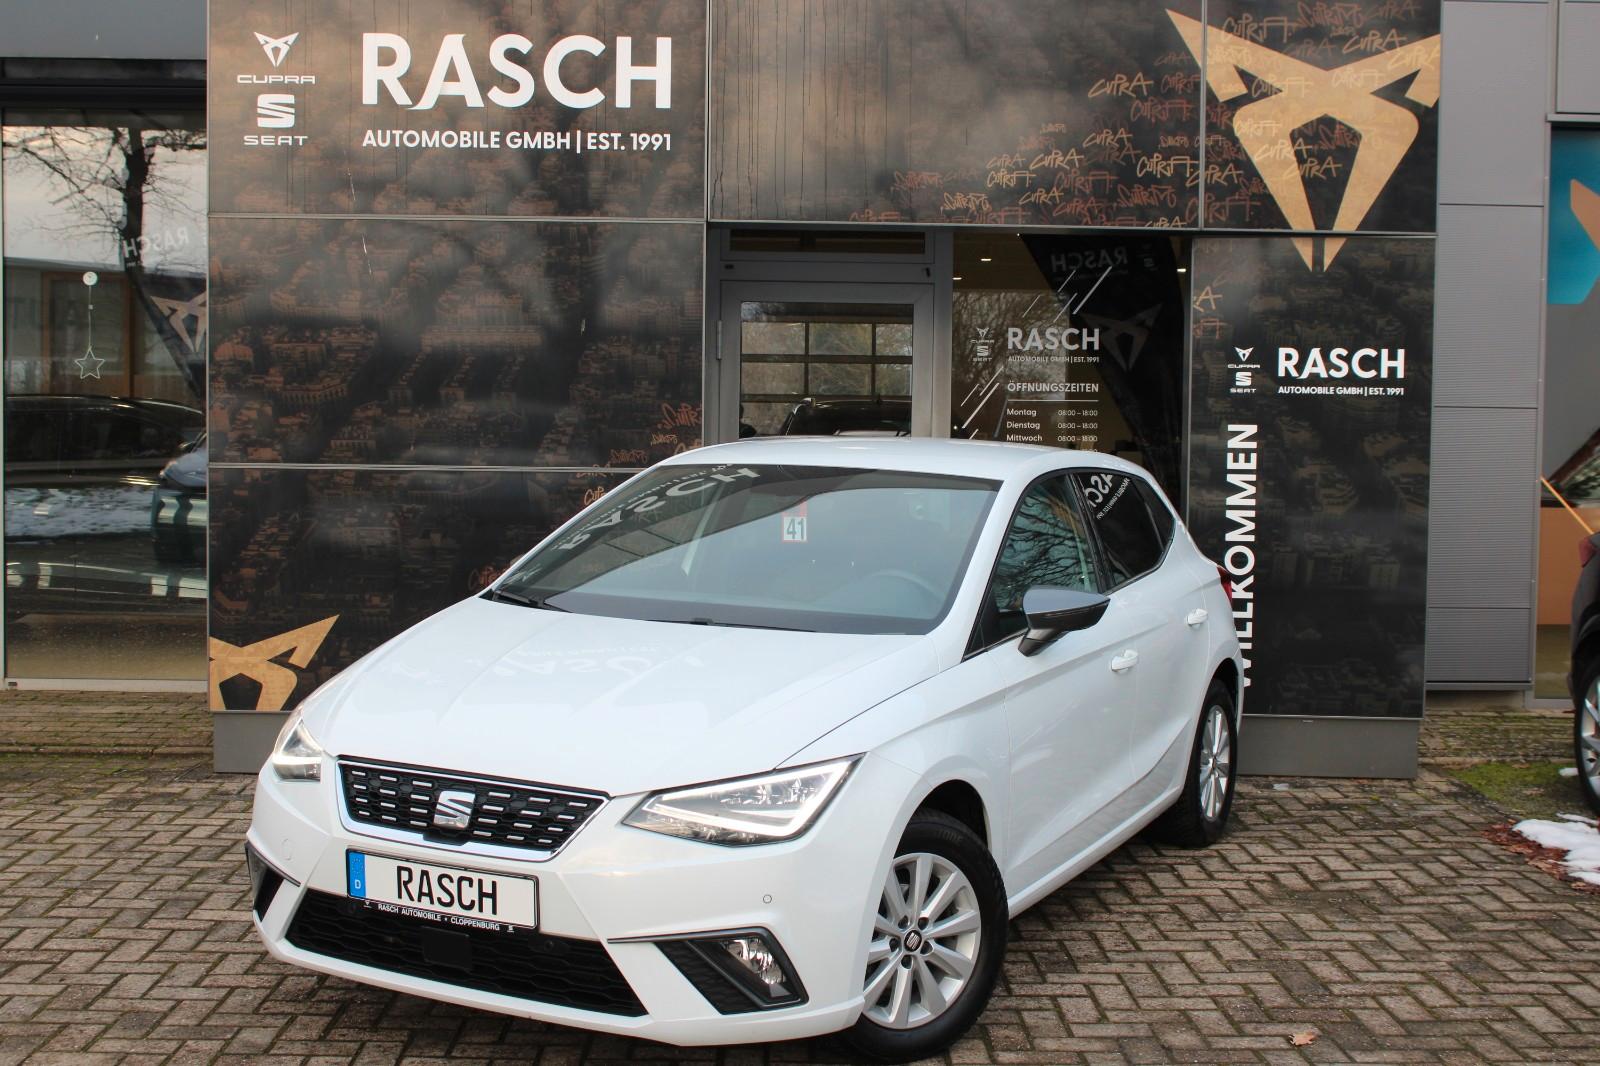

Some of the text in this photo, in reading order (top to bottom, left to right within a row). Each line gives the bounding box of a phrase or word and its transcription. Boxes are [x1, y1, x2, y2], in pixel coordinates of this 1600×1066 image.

[237, 75, 316, 84] CUPRA
[362, 32, 672, 110] RASCH
[243, 135, 309, 146] SEAT
[362, 130, 500, 148] AUTOMOBILE
[505, 131, 571, 149] GMBH
[586, 132, 625, 150] EST.
[630, 133, 671, 151] 1991
[1007, 327, 1100, 351] RASCH
[1277, 347, 1405, 379] RASCH
[1007, 380, 1099, 392] ÖFFNUNGSZEITEN
[1278, 386, 1335, 395] AUTOMOBILE
[1336, 387, 1364, 395] GMBH
[1369, 387, 1386, 396] EST.
[1386, 387, 1404, 396] 1991
[1006, 408, 1037, 417] Montag
[1006, 421, 1041, 430] Dienstag
[1006, 434, 1043, 442] Mittwoch
[786, 517, 805, 540] 41
[1223, 424, 1258, 688] LLKOMMEN
[396, 864, 498, 915] RASCH
[377, 903, 400, 914] RASCH
[401, 908, 441, 922] AUTOMOBILE
[450, 917, 500, 931] CLOPPENBURG
